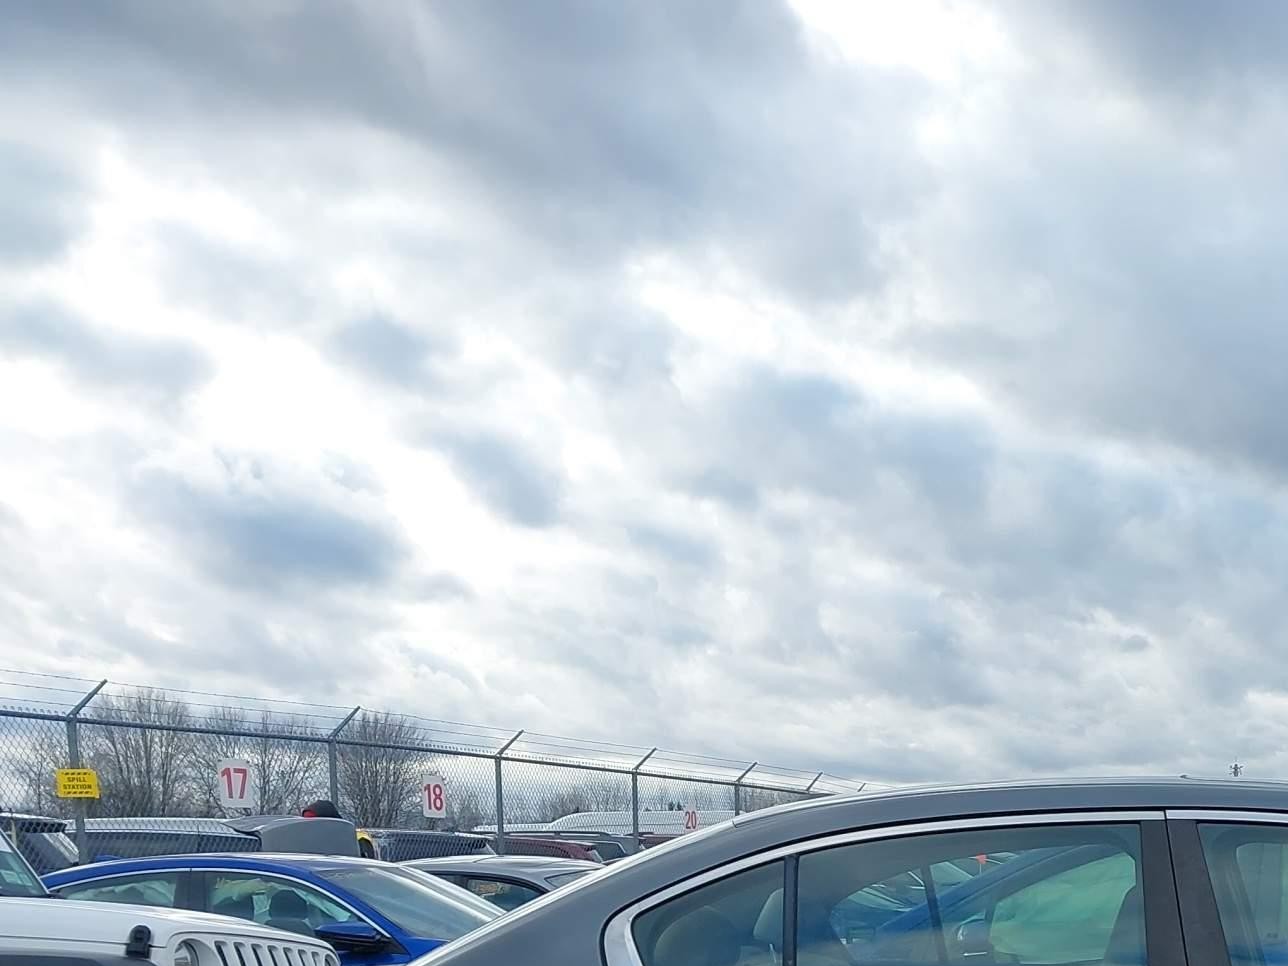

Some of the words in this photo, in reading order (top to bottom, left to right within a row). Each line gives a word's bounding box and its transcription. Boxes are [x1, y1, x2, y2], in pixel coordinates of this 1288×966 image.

[220, 767, 247, 799] 17
[424, 783, 443, 811] 18
[685, 811, 697, 829] 20
